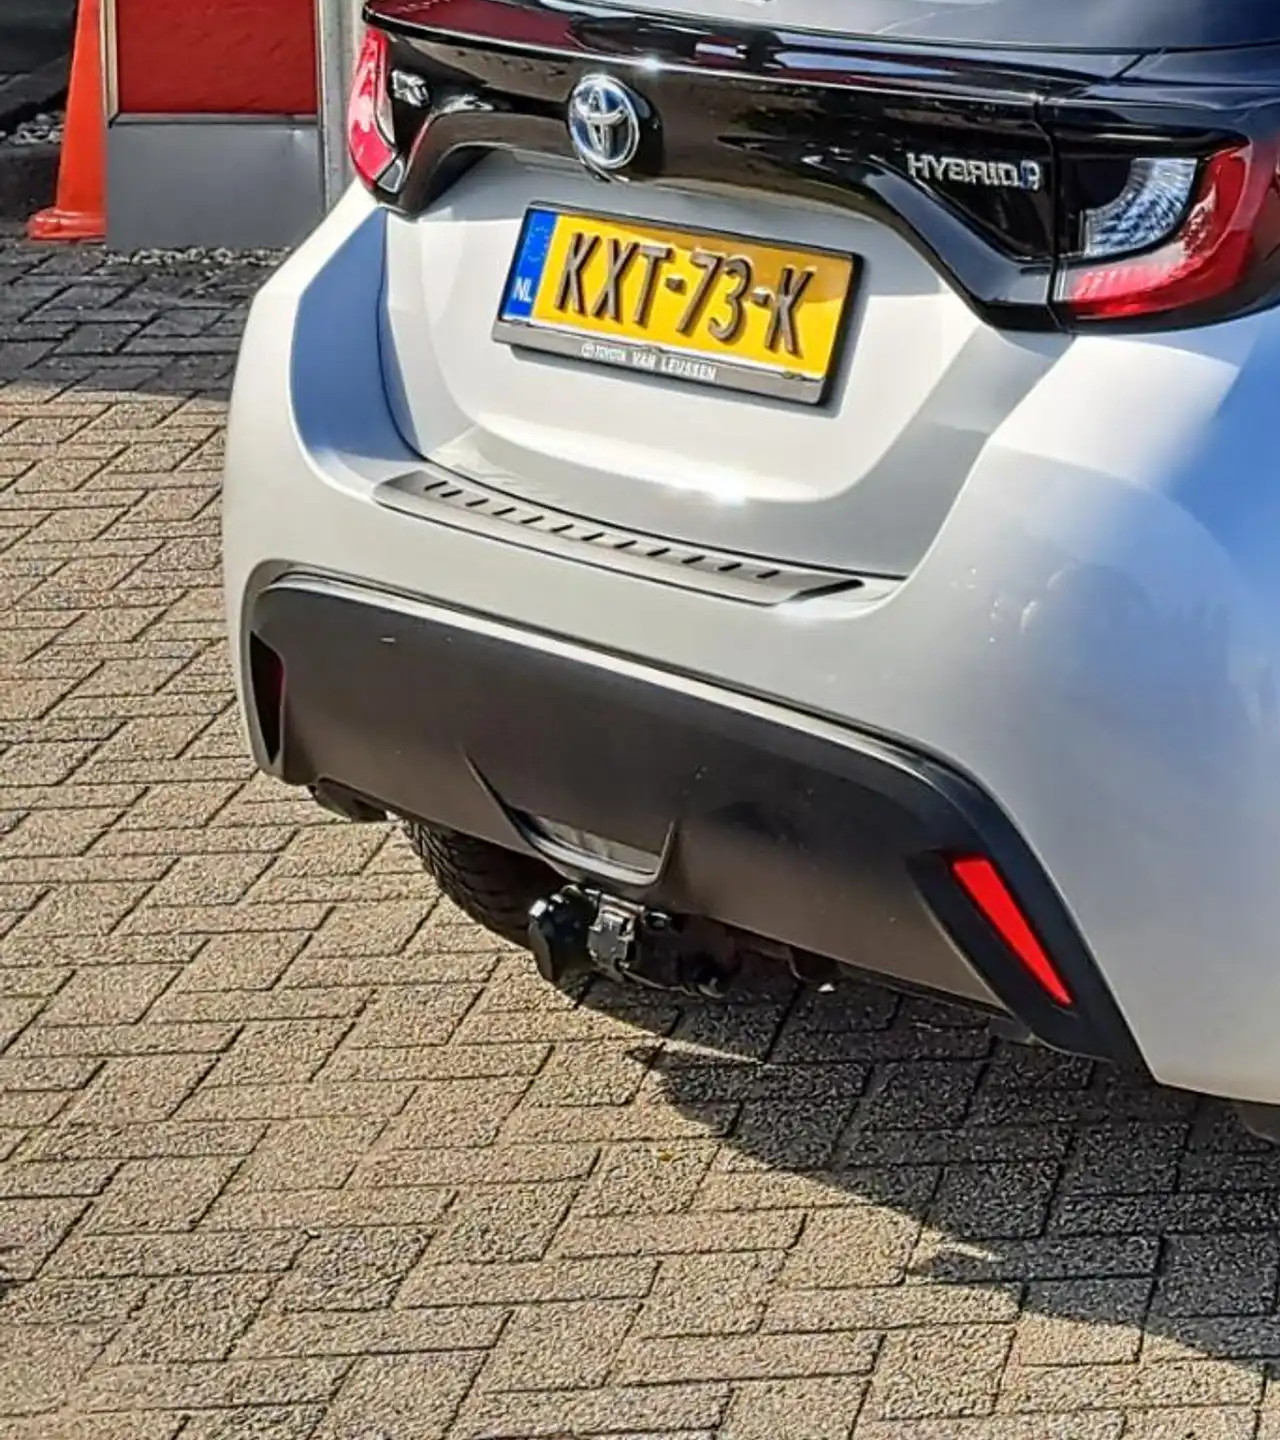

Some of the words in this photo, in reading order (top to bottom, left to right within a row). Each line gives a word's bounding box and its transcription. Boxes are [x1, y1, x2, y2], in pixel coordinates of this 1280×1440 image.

[905, 151, 1020, 189] HYBRID
[512, 276, 533, 303] NL
[555, 232, 817, 360] KXT-73-K
[631, 350, 657, 371] VAN
